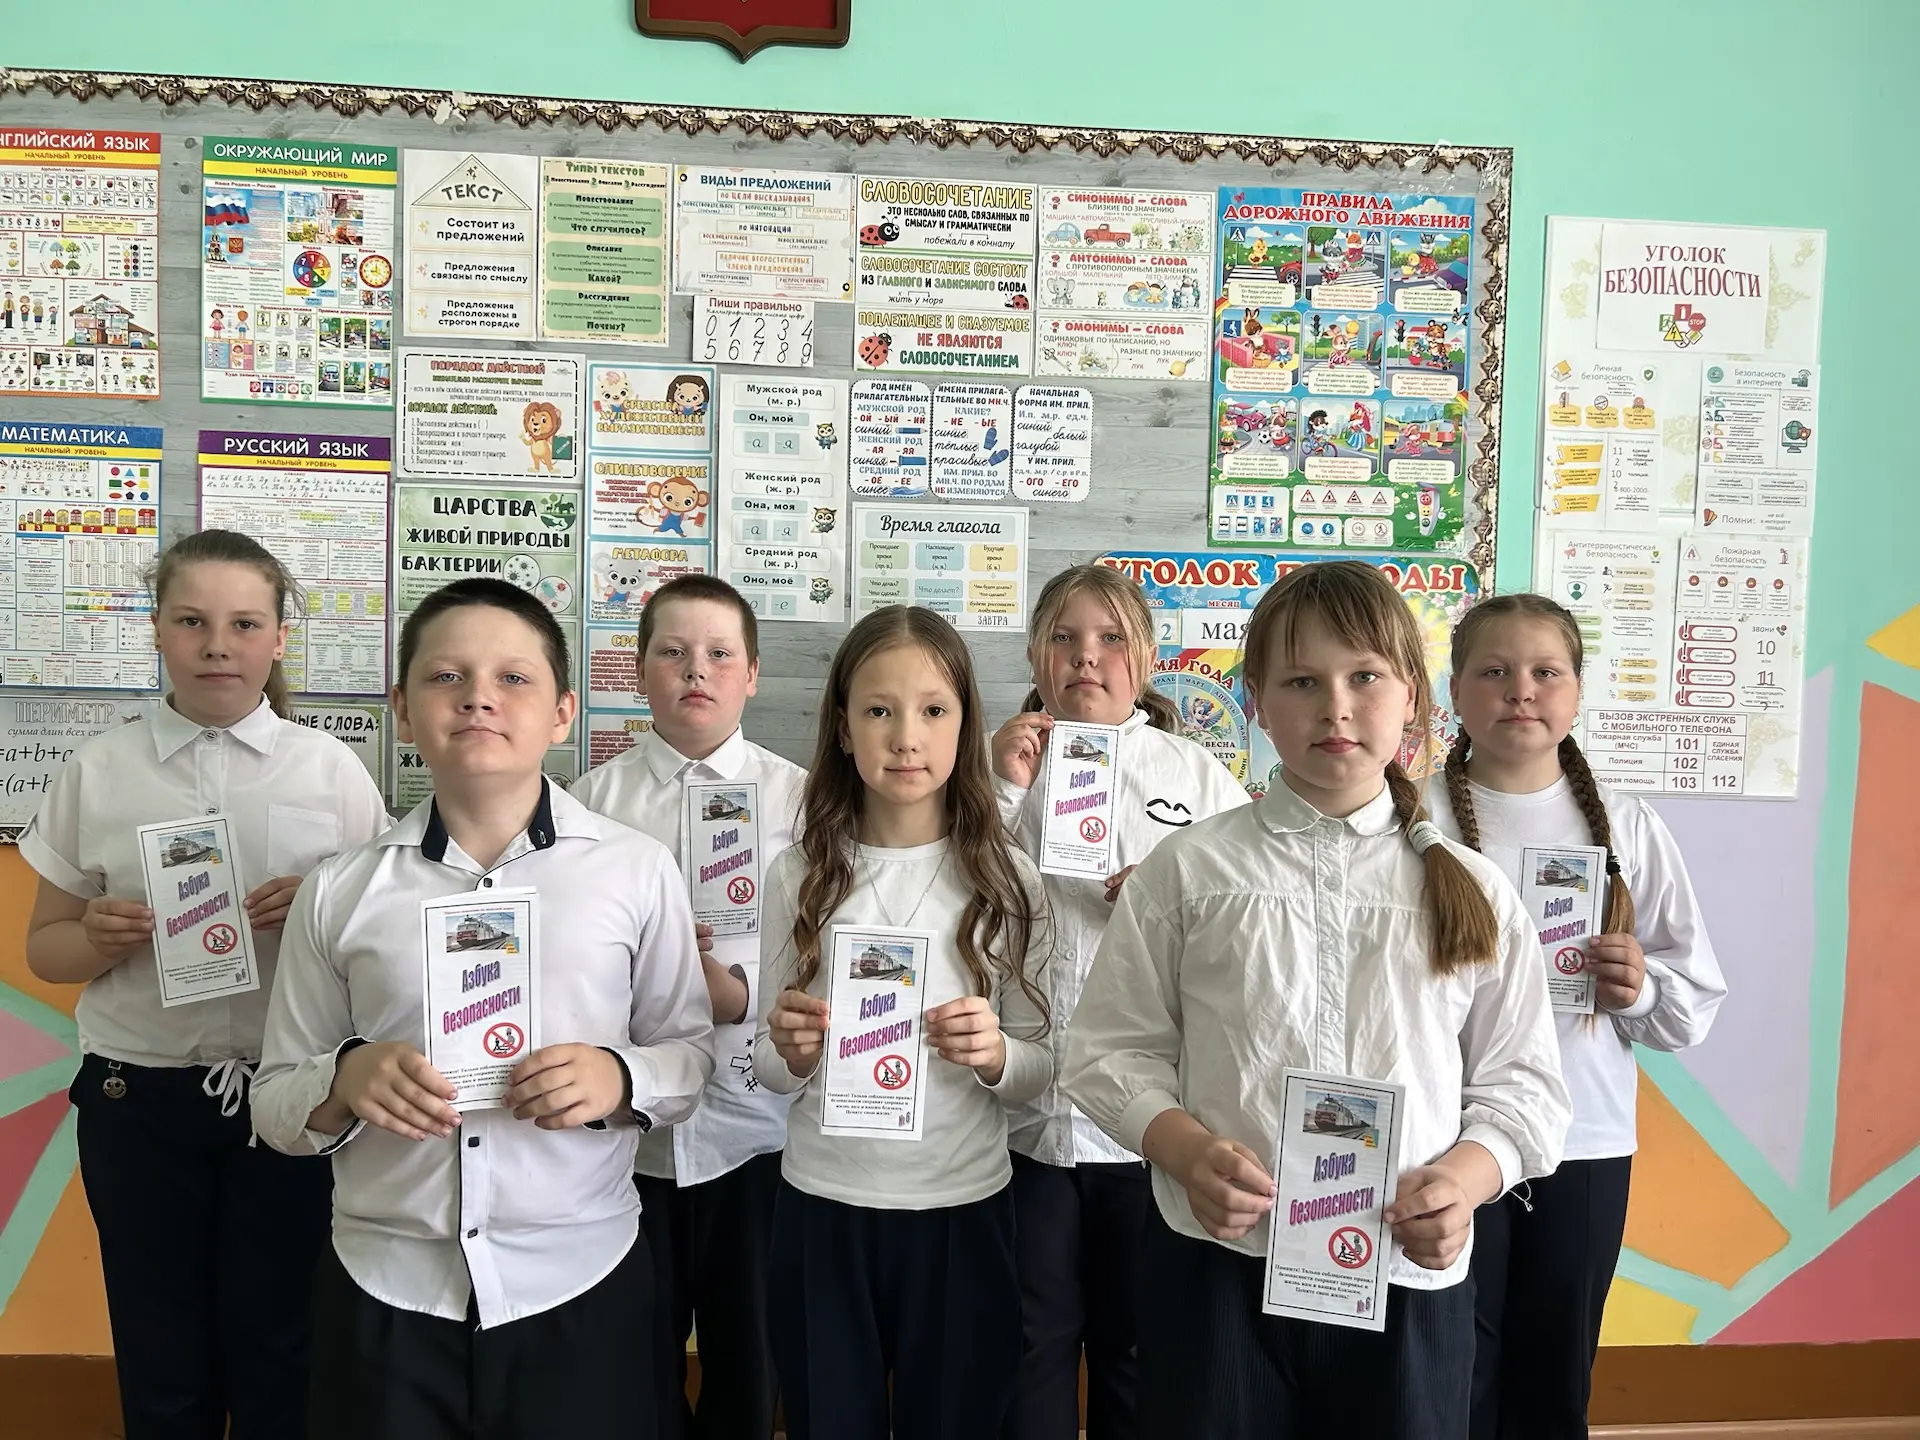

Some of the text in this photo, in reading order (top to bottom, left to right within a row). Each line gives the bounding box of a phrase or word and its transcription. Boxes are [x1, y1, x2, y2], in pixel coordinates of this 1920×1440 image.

[104, 135, 150, 151] ЯЗЫК
[24, 152, 106, 161] НАЧАЛЬНЫЙ УРОВЕНЬ
[214, 144, 388, 166] ОКРУЖАЮЩИЙ МИР
[255, 167, 348, 179] НАЧАЛЬНЫЙ УРОВЕНЬ
[701, 175, 831, 191] ВИДЫ ПРЕДЛОЖЕНИЙ
[441, 183, 503, 203] ТЕКСТ
[861, 180, 1032, 210] СЛОВОСОЧЕТАНИЕ
[1068, 193, 1187, 206] СИНОНИМЫ СЛОВА
[1301, 192, 1393, 210] ПРАВИЛА
[887, 207, 1029, 222] ЭТО НЕСКОЛЬКО СЛОВ, СВЯЗАННЫХ ПО
[1223, 206, 1471, 229] ДОРОЖНОГО ДВИЖЕНИЯ
[447, 217, 515, 230] Состоит из
[437, 229, 525, 244] предложений
[1070, 255, 1187, 266] АНТОНИМЫ СЛОВА
[1645, 245, 1726, 264] УГОЛОК
[445, 262, 515, 273] Предложения
[861, 256, 1027, 278] СЛОВОСОЧЕТАНИЕ СОСТОИТ
[1072, 264, 1152, 273] ПРОТИВОПОЛОЖНЫМ
[431, 271, 528, 284] связаны по смыслу
[861, 275, 1027, 293] ИЗ ГЛАВНОГО И ЗАВИСИМОГО СЛОВА
[1605, 266, 1761, 298] БЕЗОПАСНОСТИ
[447, 300, 514, 310] Предложения
[709, 298, 802, 312] Пиши правильно
[442, 310, 509, 319] расположены
[438, 319, 520, 329] строгом порядке
[860, 312, 1029, 332] ПОДЛЕЖАЩЕЕ И СКАЗУЕМОЕ
[1065, 322, 1184, 334] ОМОНИМЫ СЛОВА
[917, 333, 1003, 349] НЕ ЯВЛЯЮТСЯ
[900, 350, 1019, 368] СЛОВОСОЧЕТАНИЕМ
[431, 360, 545, 375] ПОРЯДОК ДЕЙСТВИЙ
[1734, 369, 1786, 379] Безопасность
[871, 383, 912, 392] РОД ИМЁН
[1744, 379, 1782, 387] интернете
[746, 384, 822, 398] Мужской род
[854, 393, 929, 402] ПРИЛАГАТЕЛЬНЫХ
[1030, 389, 1079, 398] НАЧАЛЬНАЯ
[857, 404, 925, 414] МУЖСКОЙ РОД
[1018, 399, 1090, 409] ФОРМА ИМ. ПРИЛ.
[955, 407, 991, 416] КАКИЕ?
[749, 413, 793, 425] Он, мой
[3, 427, 130, 445] МАТЕМАТИКА
[24, 447, 107, 456] НАЧАЛЬНЫЙ УРОВЕНЬ
[224, 437, 369, 458] РУССКИЙ ЯЗЫК
[256, 458, 337, 468] НАЧАЛЬНЫЙ УРОВЕНЬ
[594, 462, 708, 479] ОЛИЦЕТВОРЕНИЕ
[434, 496, 537, 516] ЦАРСТВА
[881, 514, 1002, 538] Время глагола
[1721, 515, 1755, 525] Помни:
[406, 526, 570, 548] ЖИВОЙ ПРИРОДЫ
[612, 547, 688, 562] МЕТАФОРА
[1722, 547, 1761, 556] Пожарная
[402, 555, 502, 572] БАКТЕРИИ
[1715, 555, 1767, 565] безопасность
[1208, 599, 1240, 608] МЕСЯЦ
[977, 615, 1008, 625] ЗАВТРА
[1161, 622, 1172, 641] 2
[1752, 625, 1774, 633] ЗВОНИ
[1756, 640, 1776, 656] 10
[1188, 659, 1234, 690] ГОДА
[1185, 678, 1205, 686] МАРТ
[1214, 690, 1237, 714] АПРЕЛЬ
[15, 701, 115, 724] ПЕРИМЕТР
[1599, 712, 1736, 724] ВЫЗОВ ЭКСТРЕННЫХ СЛУЖБ
[7, 727, 85, 738] сумма длин всех
[1602, 723, 1732, 734] С МОБИЛЬНОГО ТЕЛЕФОНА
[1592, 733, 1662, 743] Пожарная служба
[1675, 738, 1699, 751] 101
[1614, 742, 1638, 750] (МЧС)
[1608, 758, 1643, 766] Полиция
[1672, 757, 1698, 770] 102
[1070, 769, 1096, 789] Азбука
[1624, 777, 1655, 785] помощь
[1671, 776, 1697, 789] 103
[1712, 775, 1736, 788] 112
[1055, 791, 1107, 816] безопасности
[713, 828, 738, 852] Азбука
[700, 848, 752, 883] безопасности
[178, 871, 210, 901] Азбука
[166, 891, 230, 938] безопасности
[1544, 896, 1573, 919] Азбука
[462, 960, 500, 993] Азбука
[443, 985, 520, 1035] безопасности
[859, 991, 896, 1020] Азбука
[839, 1019, 912, 1060] безопасности
[1314, 1152, 1355, 1183] Азбука
[1289, 1186, 1374, 1225] безопасности
